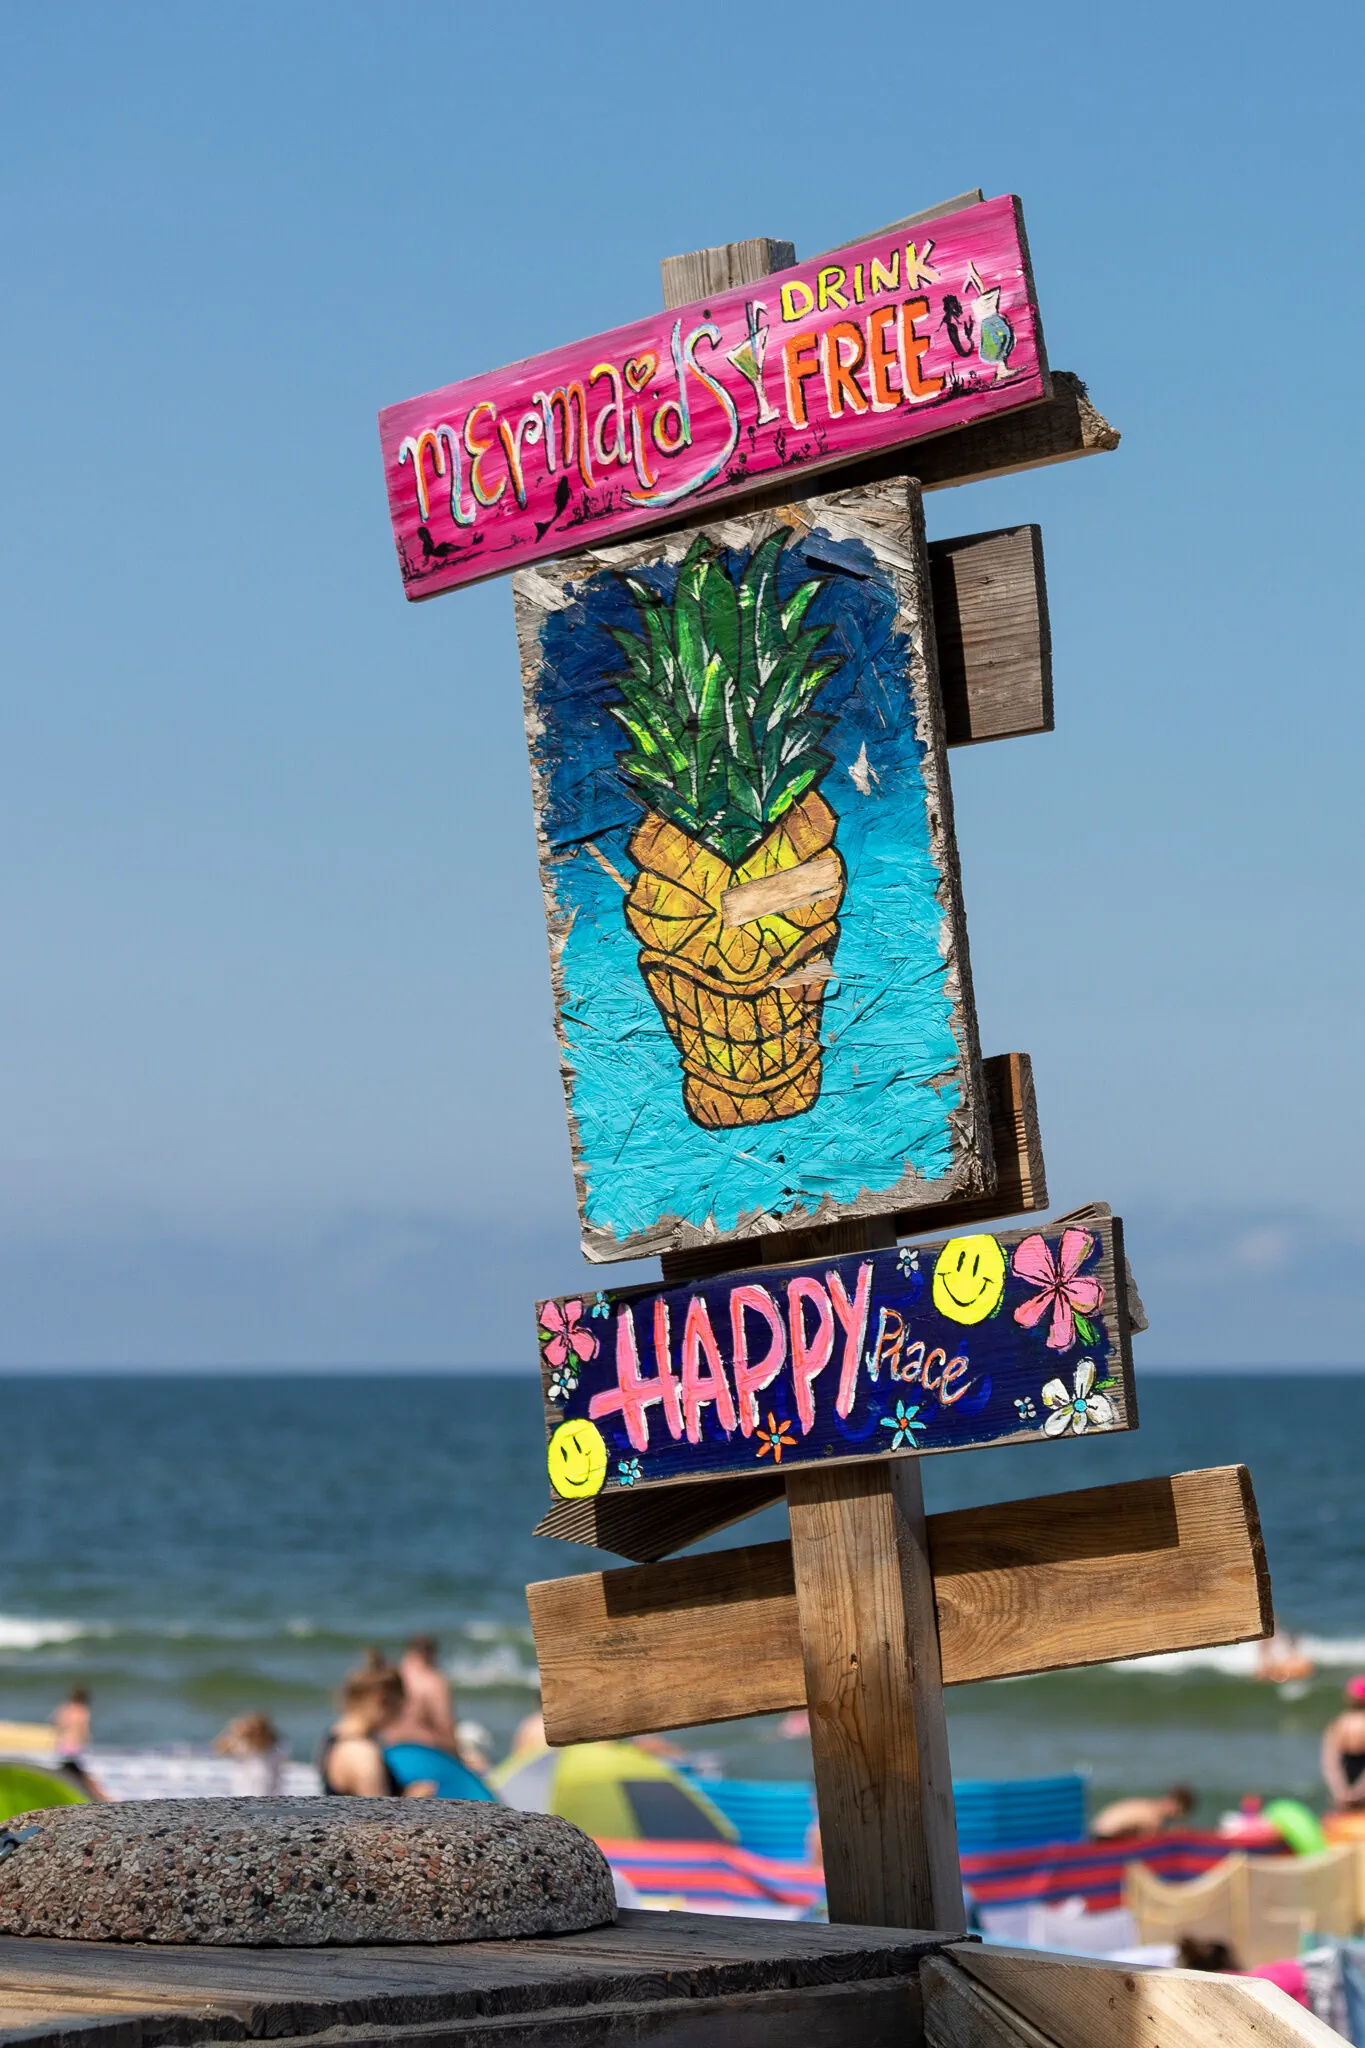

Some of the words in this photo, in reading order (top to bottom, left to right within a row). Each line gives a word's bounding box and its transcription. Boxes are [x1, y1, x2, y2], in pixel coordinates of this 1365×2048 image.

[780, 238, 941, 323] DRINK
[782, 294, 945, 430] FREE
[587, 1259, 875, 1453] HAPPY
[865, 1306, 979, 1406] Place
